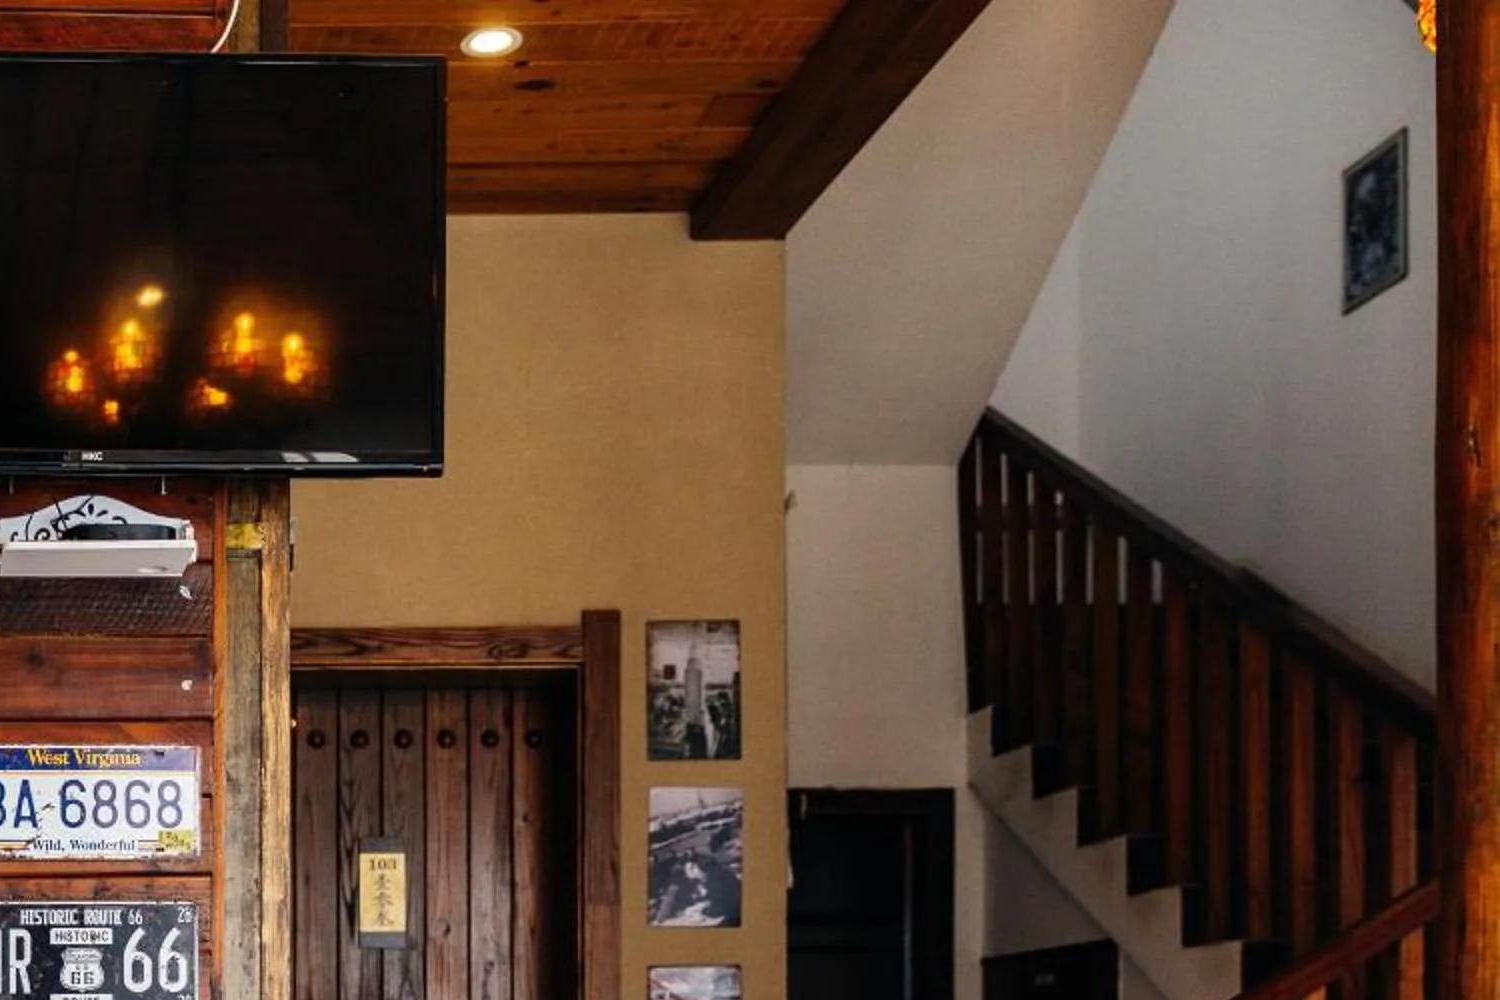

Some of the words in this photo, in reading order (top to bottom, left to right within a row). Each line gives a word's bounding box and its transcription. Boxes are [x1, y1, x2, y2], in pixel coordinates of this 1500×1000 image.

[26, 748, 70, 766] West
[72, 748, 142, 769] Virginia
[69, 839, 136, 852] Wonderful
[20, 909, 79, 925] HISTORIC
[83, 909, 122, 925] ROUTE
[123, 927, 188, 993] 66
